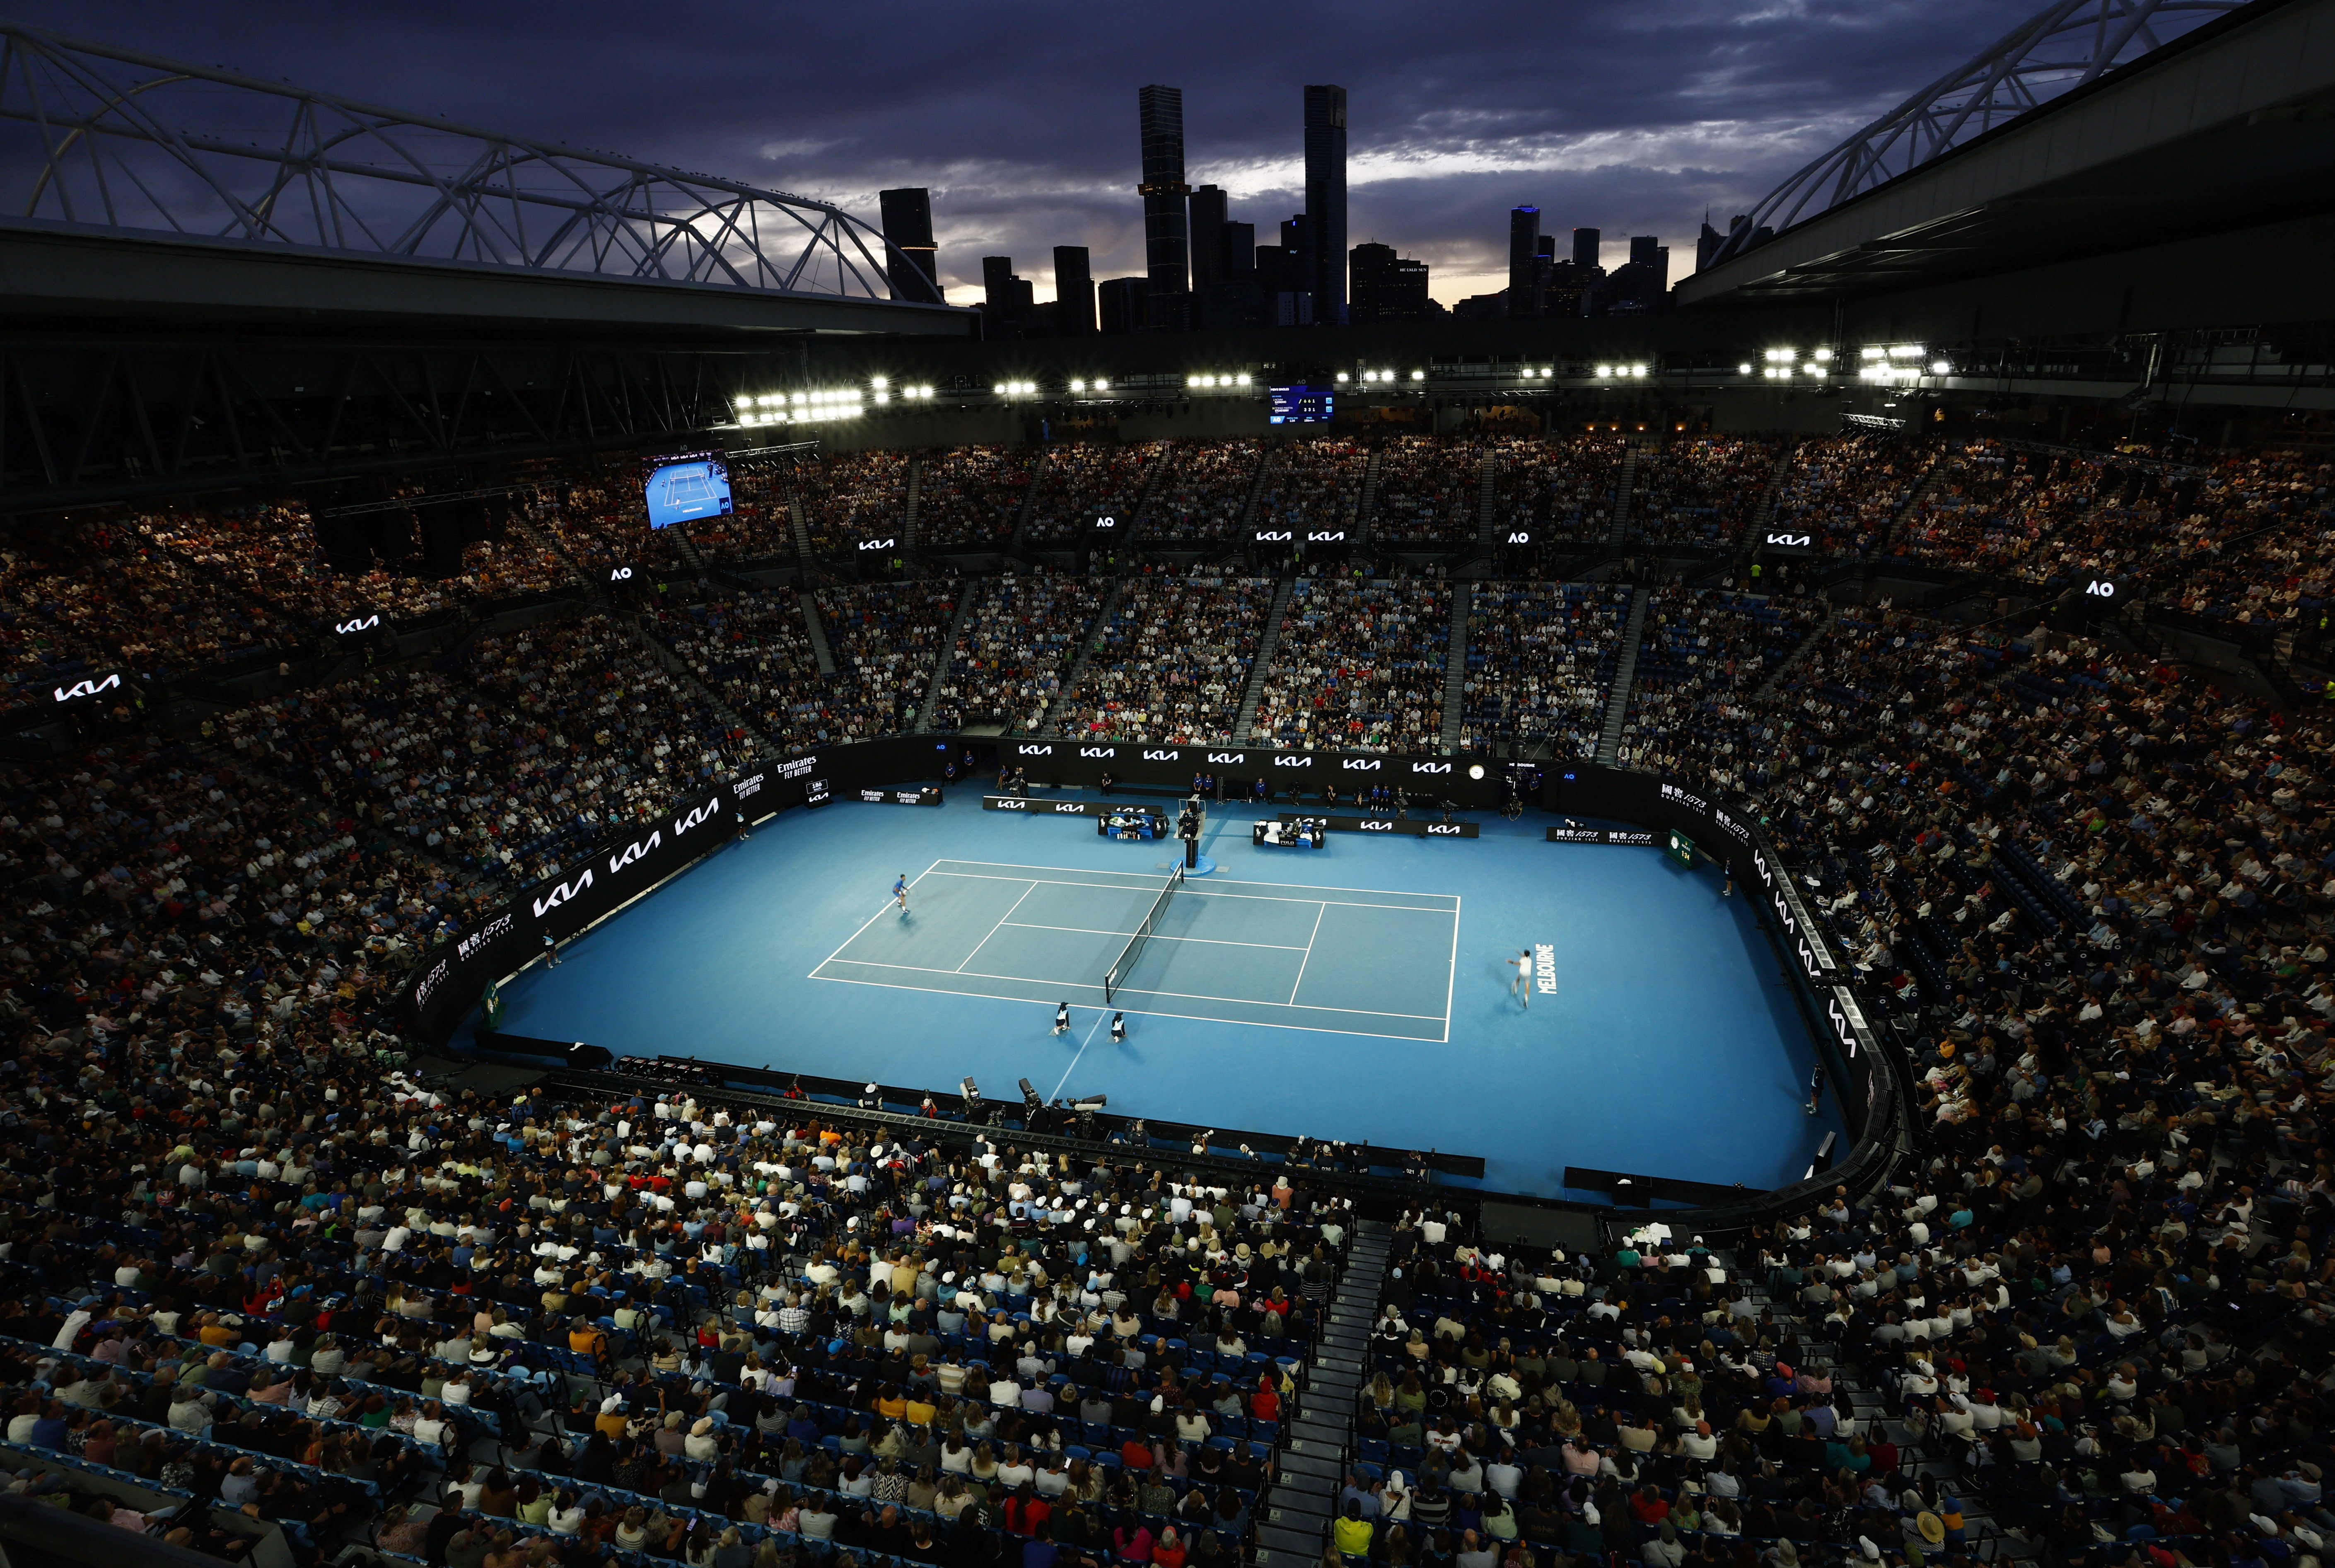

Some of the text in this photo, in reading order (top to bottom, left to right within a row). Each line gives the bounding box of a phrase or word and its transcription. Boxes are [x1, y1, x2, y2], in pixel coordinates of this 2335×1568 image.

[1096, 517, 1114, 527] AO
[1257, 532, 1291, 540] KIA
[1309, 532, 1344, 541] KIA
[1508, 533, 1528, 543] AO
[1768, 534, 1810, 546] KIA
[859, 539, 894, 550] KIA
[611, 568, 631, 580] AO
[2086, 581, 2113, 597] AO
[336, 615, 379, 633] KIA
[54, 674, 120, 703] KIA
[1019, 745, 1051, 755] KIA
[1081, 748, 1114, 757] KIA
[1144, 750, 1178, 760] KIA
[1208, 753, 1244, 763] KIA
[1275, 756, 1311, 766] KIA
[777, 756, 816, 773] Emirates
[1343, 759, 1380, 770] KIA
[1413, 762, 1451, 773] KIA
[785, 765, 811, 779] FLY BETTER
[733, 773, 764, 794] Emirates
[746, 783, 760, 797] BETTER
[809, 792, 828, 802] KIA
[1056, 804, 1084, 812] KIA
[1661, 794, 1705, 815] GUOJIAO 1573
[675, 797, 719, 835] KIA
[1361, 821, 1392, 830] KIA
[1428, 825, 1460, 834] KIA
[1716, 819, 1748, 846] GUOJIAO 1573
[610, 831, 660, 873] KIA
[1682, 843, 1690, 852] ROLEX
[1681, 850, 1690, 861] 1:34
[1754, 849, 1772, 887] KIA
[533, 867, 593, 917] KIA
[1775, 891, 1794, 933] KIA
[461, 924, 514, 962] GUOJIAO 1573
[1536, 944, 1557, 994] MELBOURNE
[437, 971, 449, 985] 1573
[1829, 999, 1856, 1058] KIA
